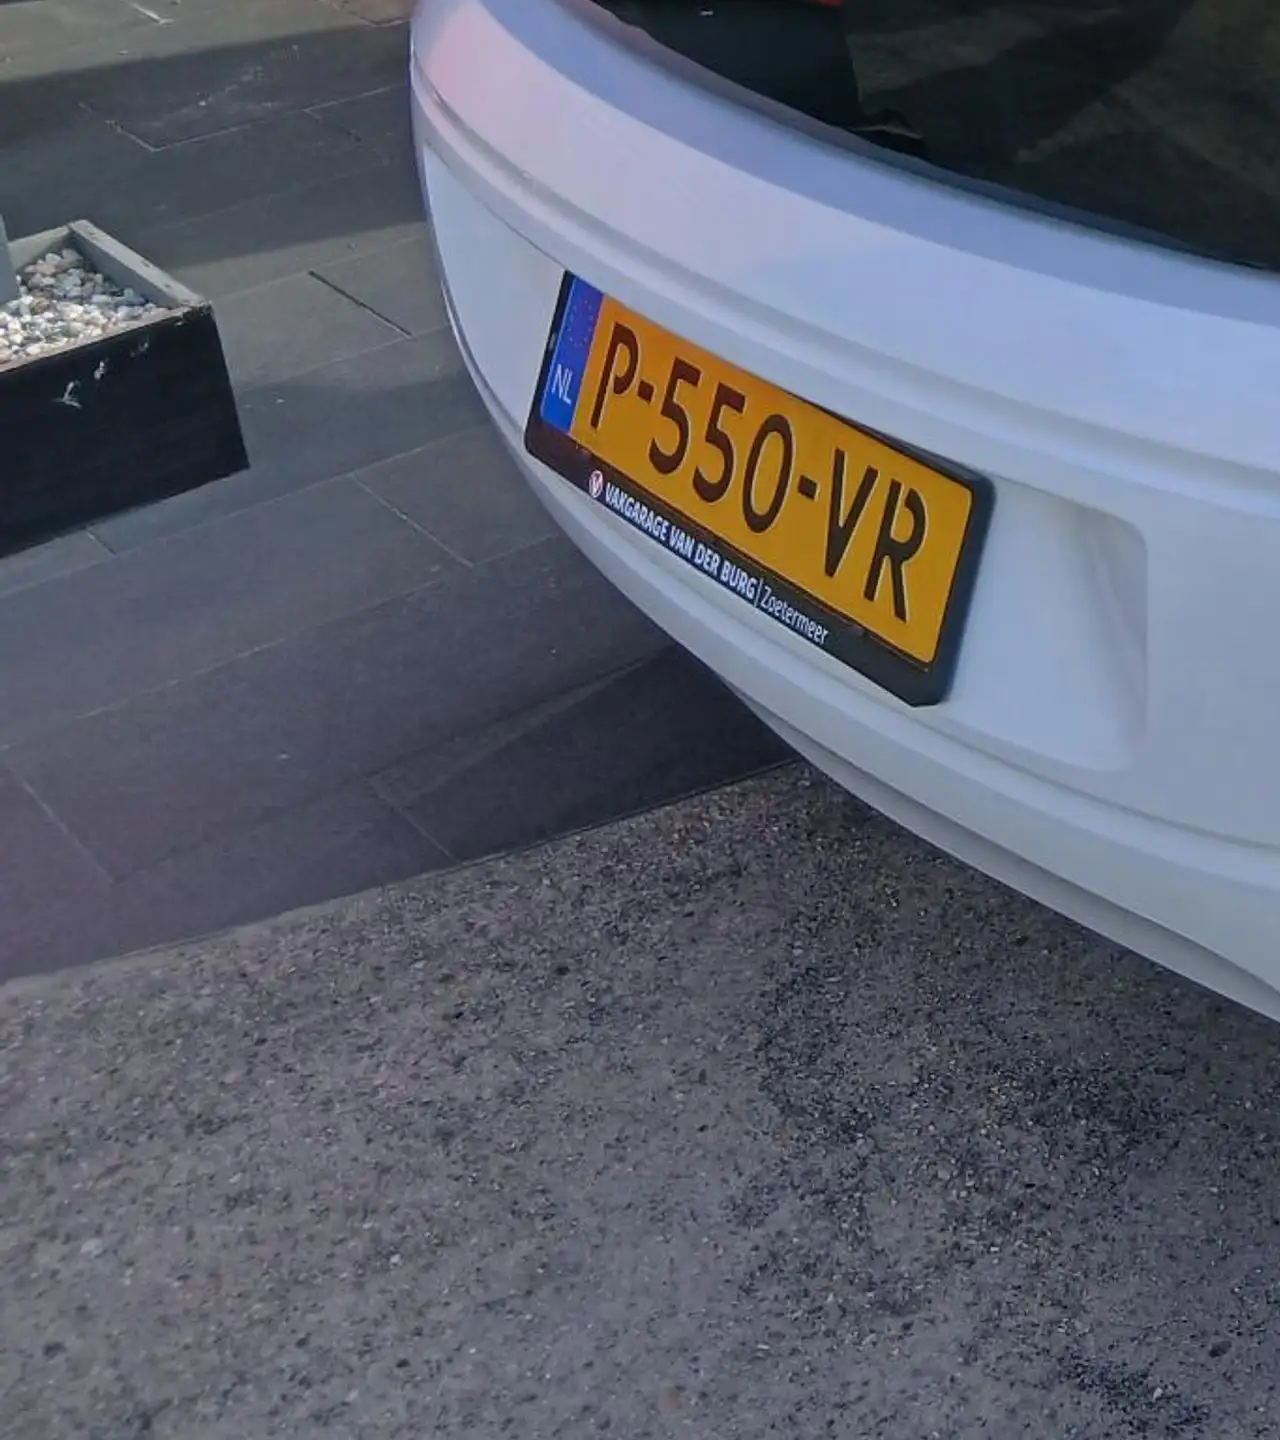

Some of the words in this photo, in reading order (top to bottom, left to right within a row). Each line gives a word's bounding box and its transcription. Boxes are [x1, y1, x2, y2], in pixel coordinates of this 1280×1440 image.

[551, 362, 573, 405] NL
[590, 321, 928, 622] P-550-VR
[604, 481, 668, 541] VAKGARAGE
[669, 524, 694, 559] VAN
[694, 540, 721, 577] DER
[720, 560, 759, 601] BURG
[760, 584, 829, 646] Zoetermeer
